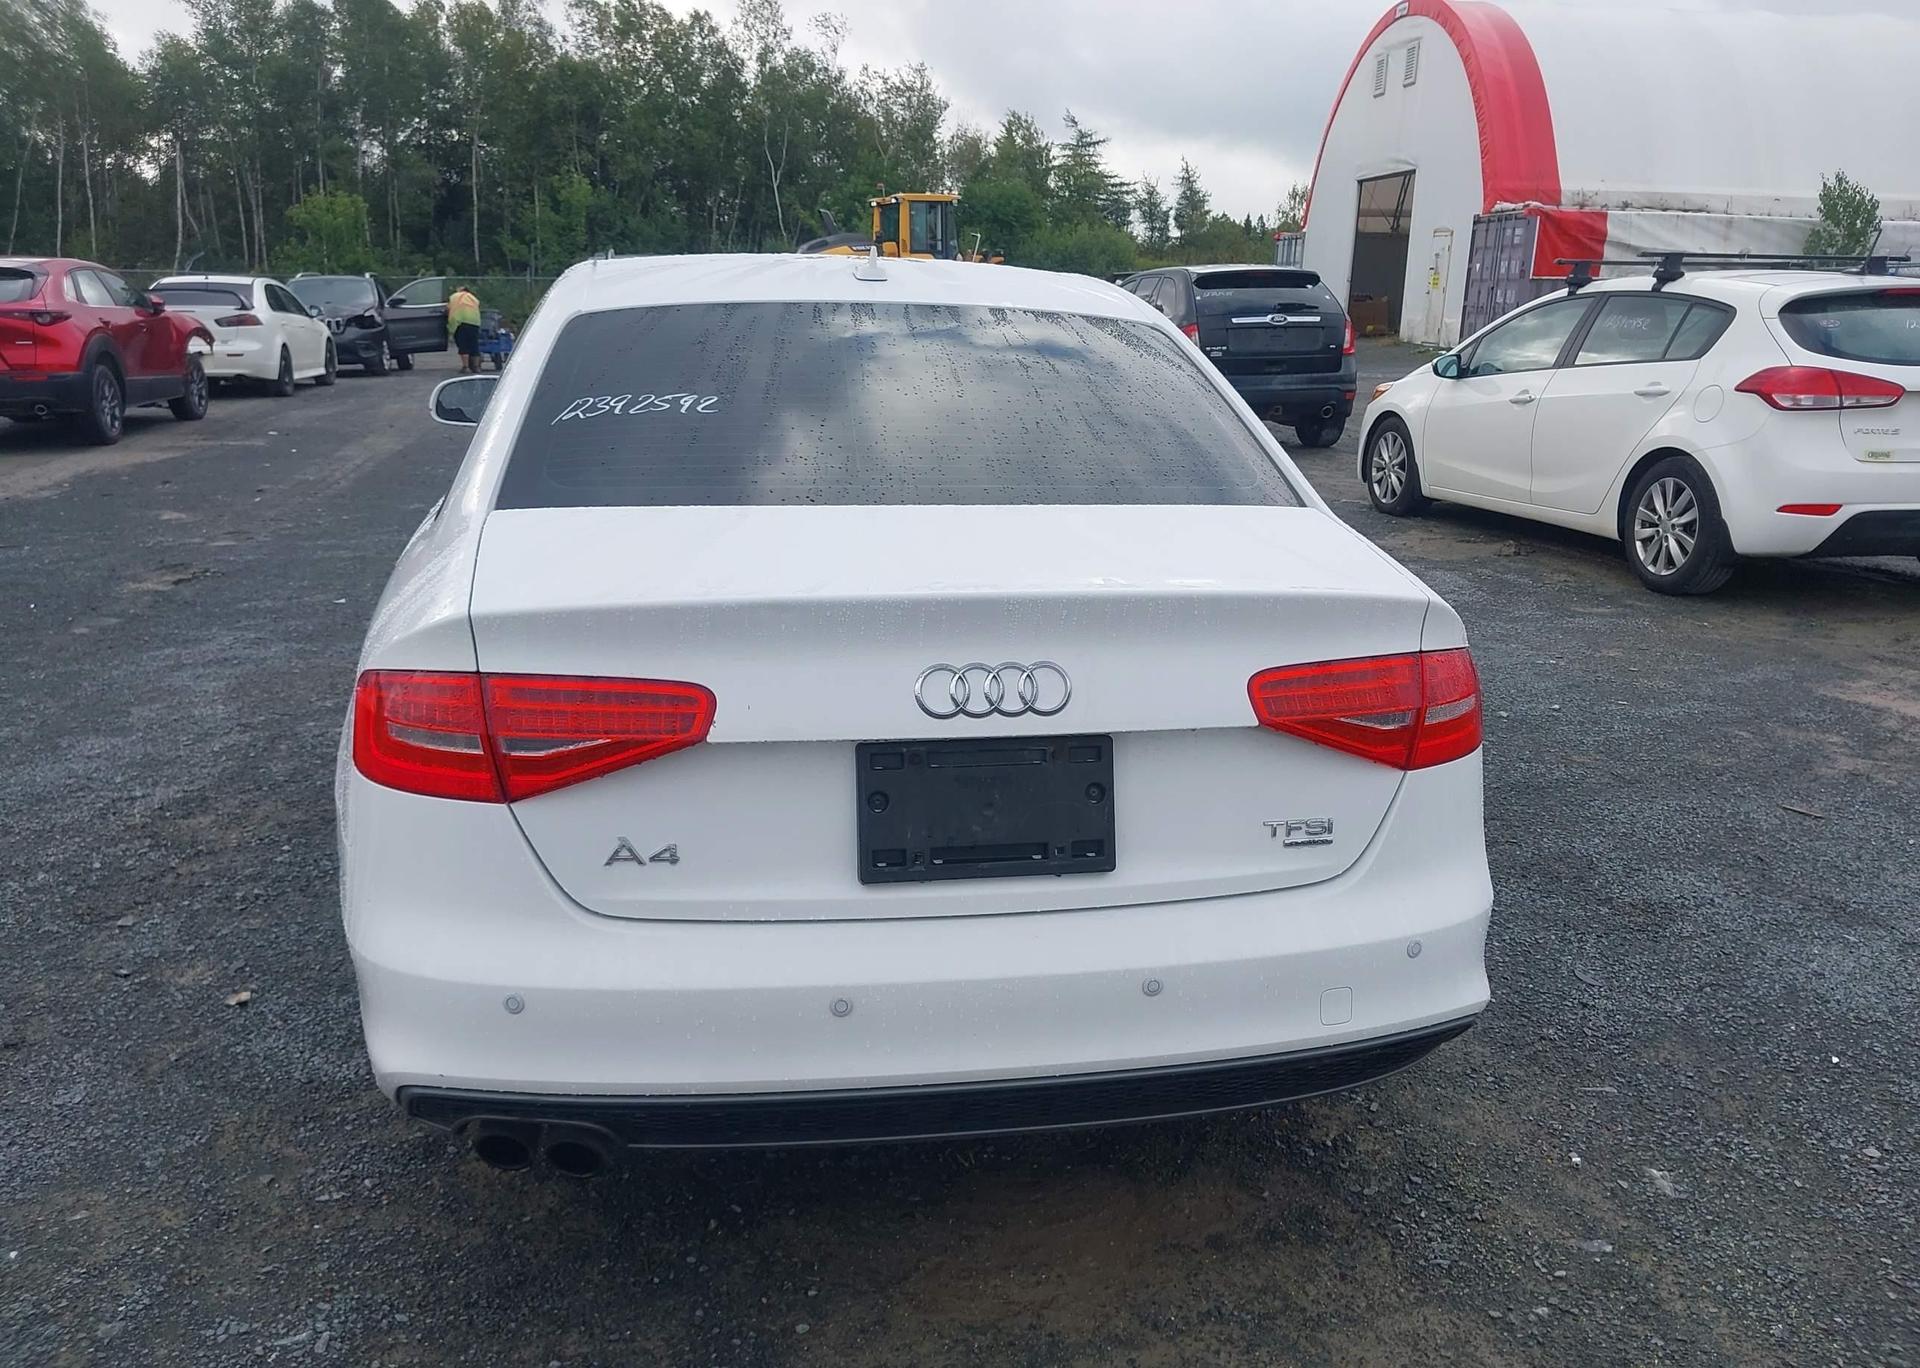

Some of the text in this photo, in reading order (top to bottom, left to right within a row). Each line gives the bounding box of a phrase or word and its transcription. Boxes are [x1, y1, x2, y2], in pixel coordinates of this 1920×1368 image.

[551, 393, 719, 426] 12392592
[1263, 817, 1334, 838] TFSI
[603, 836, 680, 867] A4
